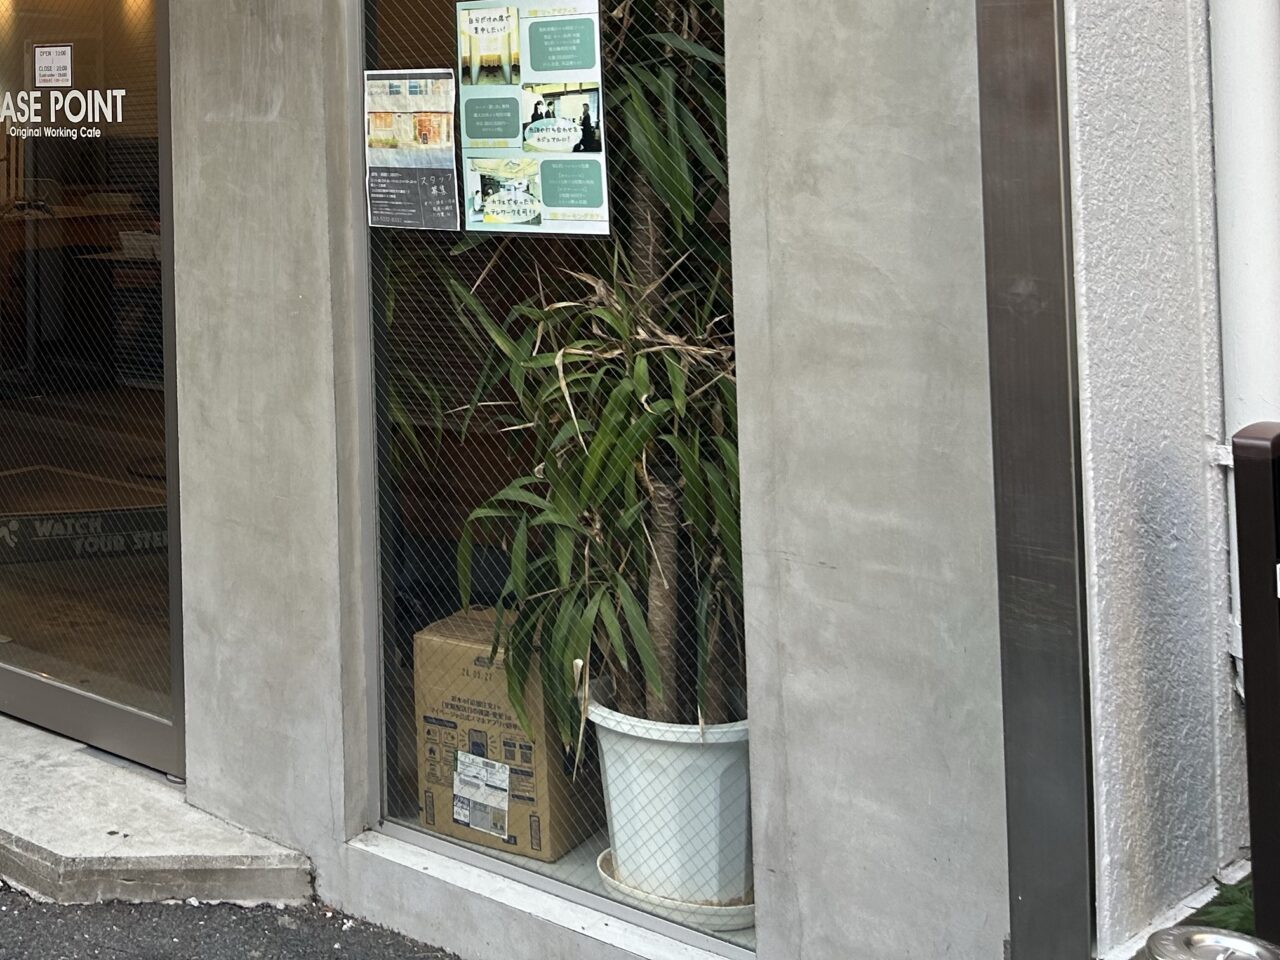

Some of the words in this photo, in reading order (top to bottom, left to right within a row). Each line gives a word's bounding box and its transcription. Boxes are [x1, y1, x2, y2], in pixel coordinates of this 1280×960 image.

[50, 89, 126, 123] POINT
[9, 126, 42, 139] Original
[43, 126, 77, 140] Working
[79, 126, 102, 138] Cafe
[34, 518, 103, 537] WATCH
[133, 529, 168, 549] STE
